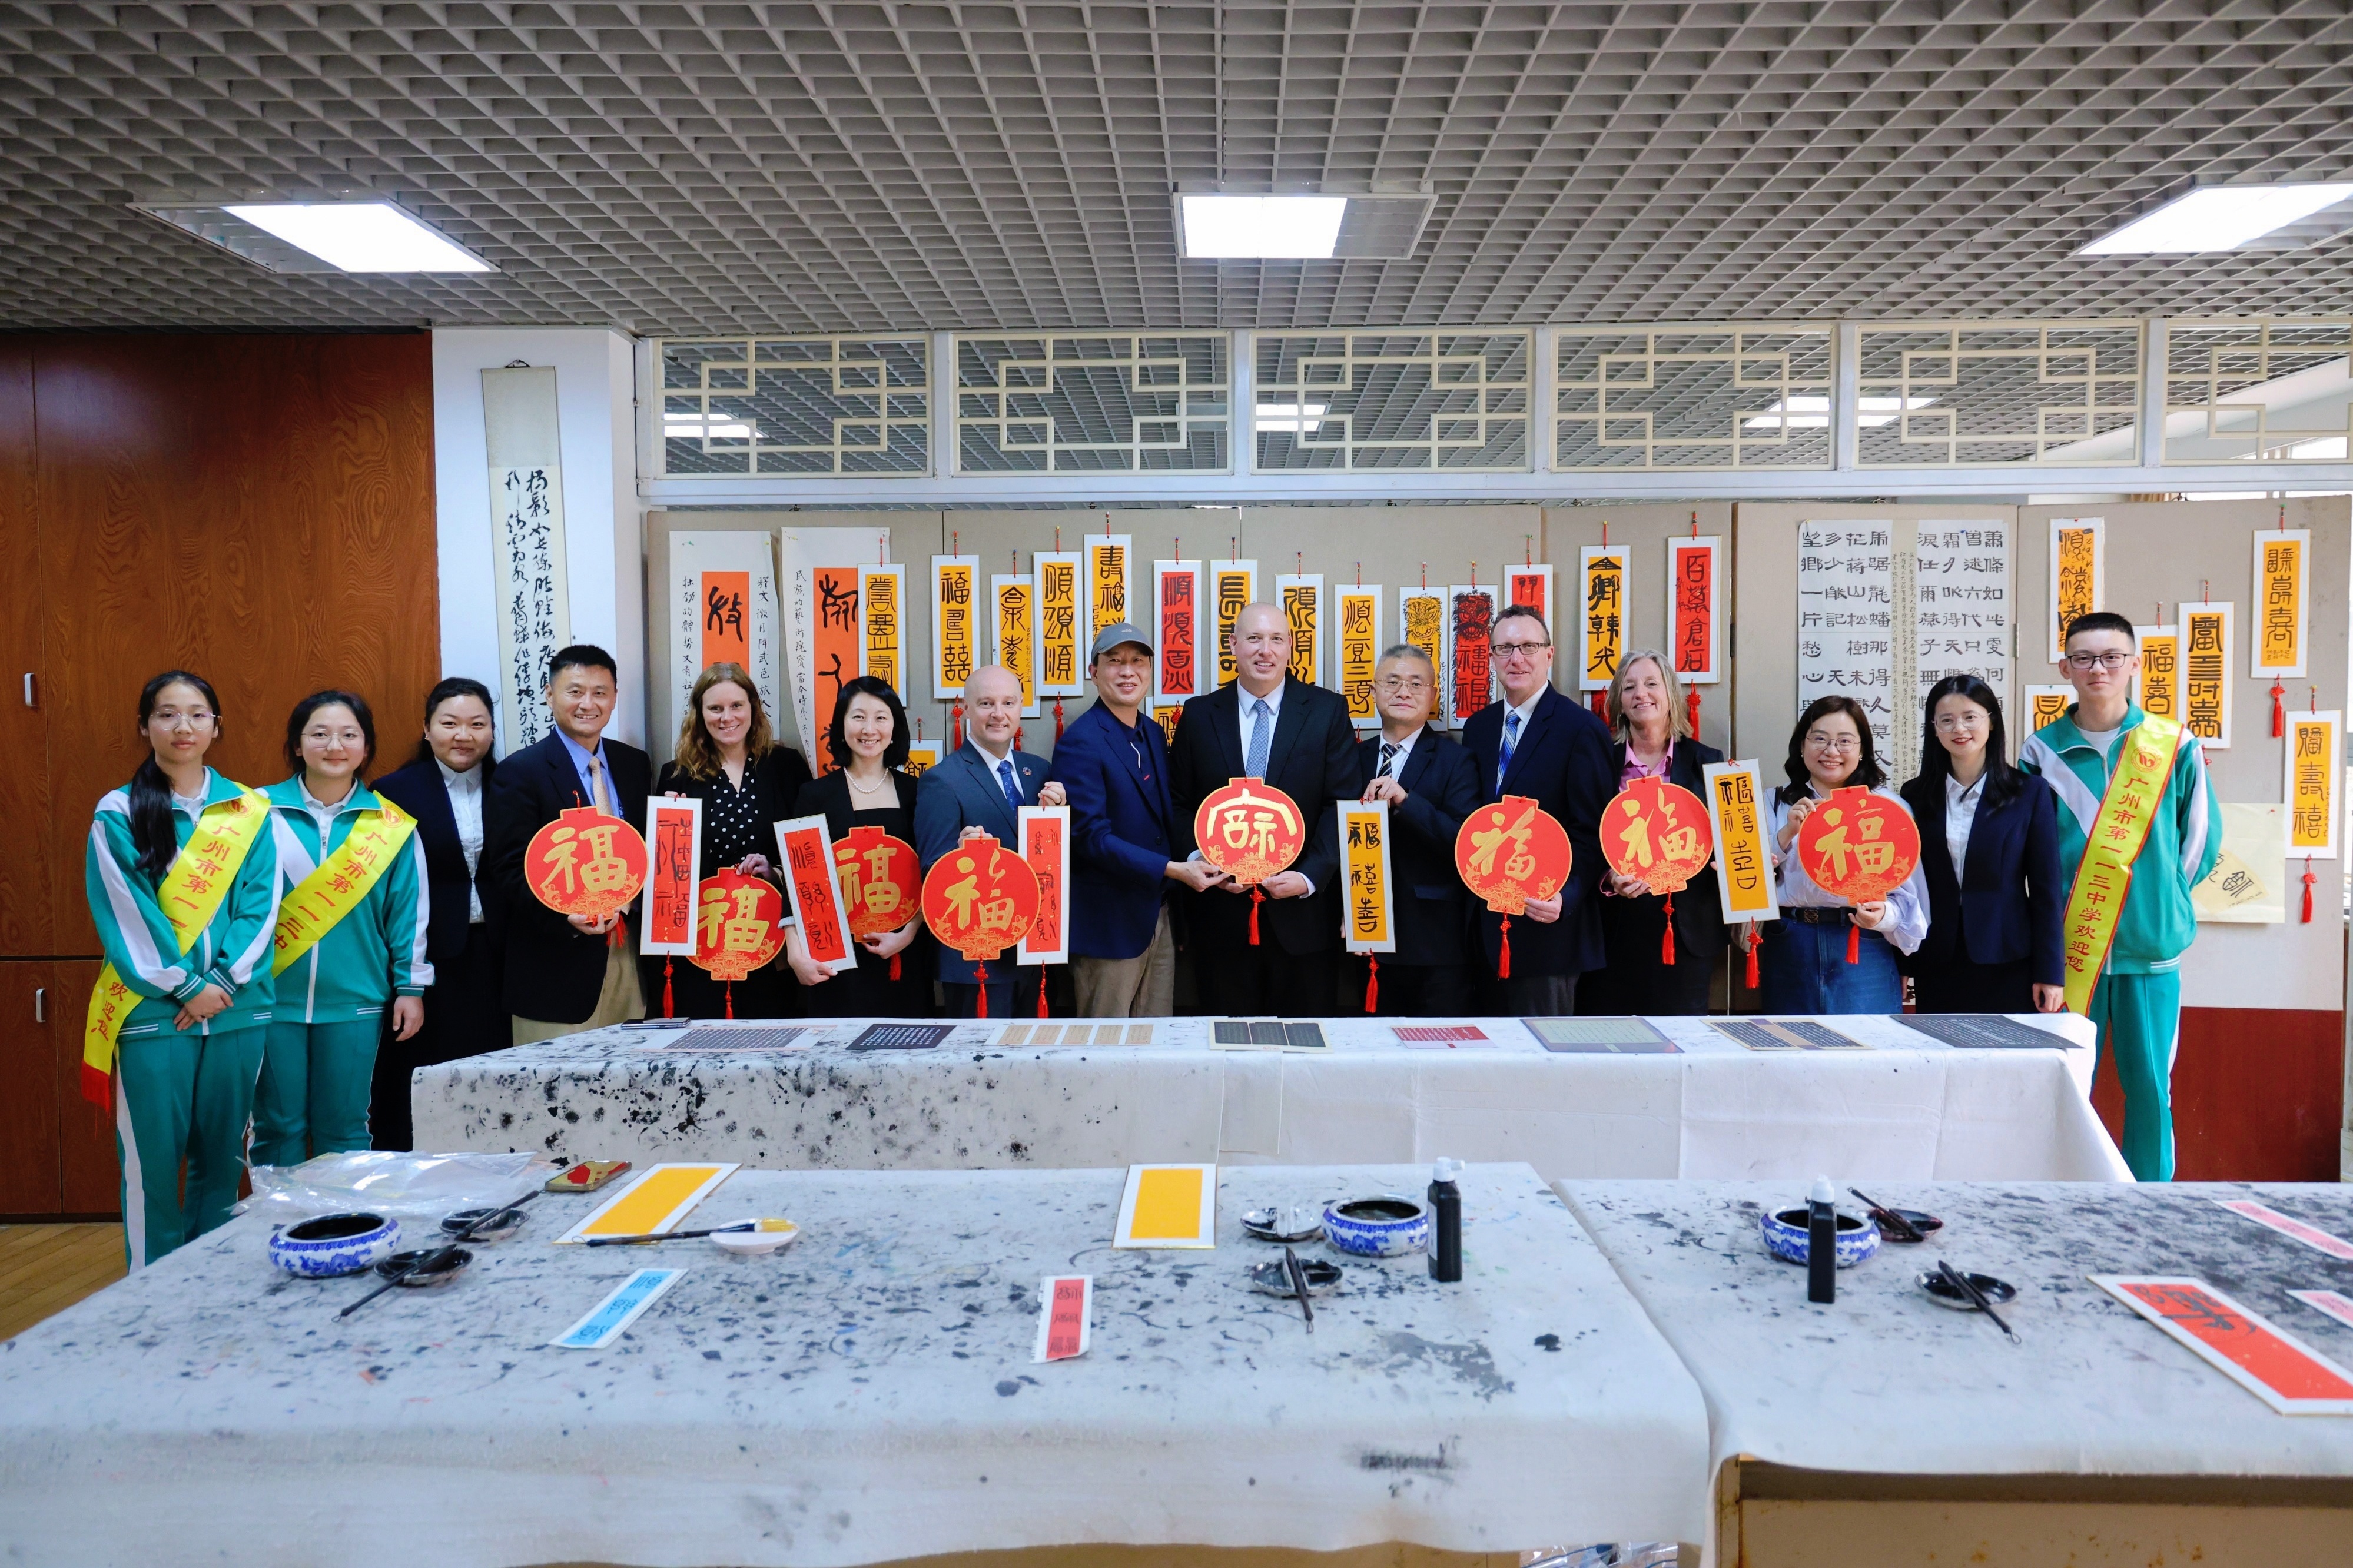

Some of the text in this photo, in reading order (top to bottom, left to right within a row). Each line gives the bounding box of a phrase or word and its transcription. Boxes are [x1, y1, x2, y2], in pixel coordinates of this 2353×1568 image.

[540, 825, 628, 894] 福
[1619, 786, 1697, 868] 福
[1814, 798, 1896, 881] 福
[837, 843, 901, 913] 福
[944, 848, 1014, 931] 福
[2063, 776, 2149, 973] 广州市第一一三中学欢迎您
[697, 884, 770, 952] 福
